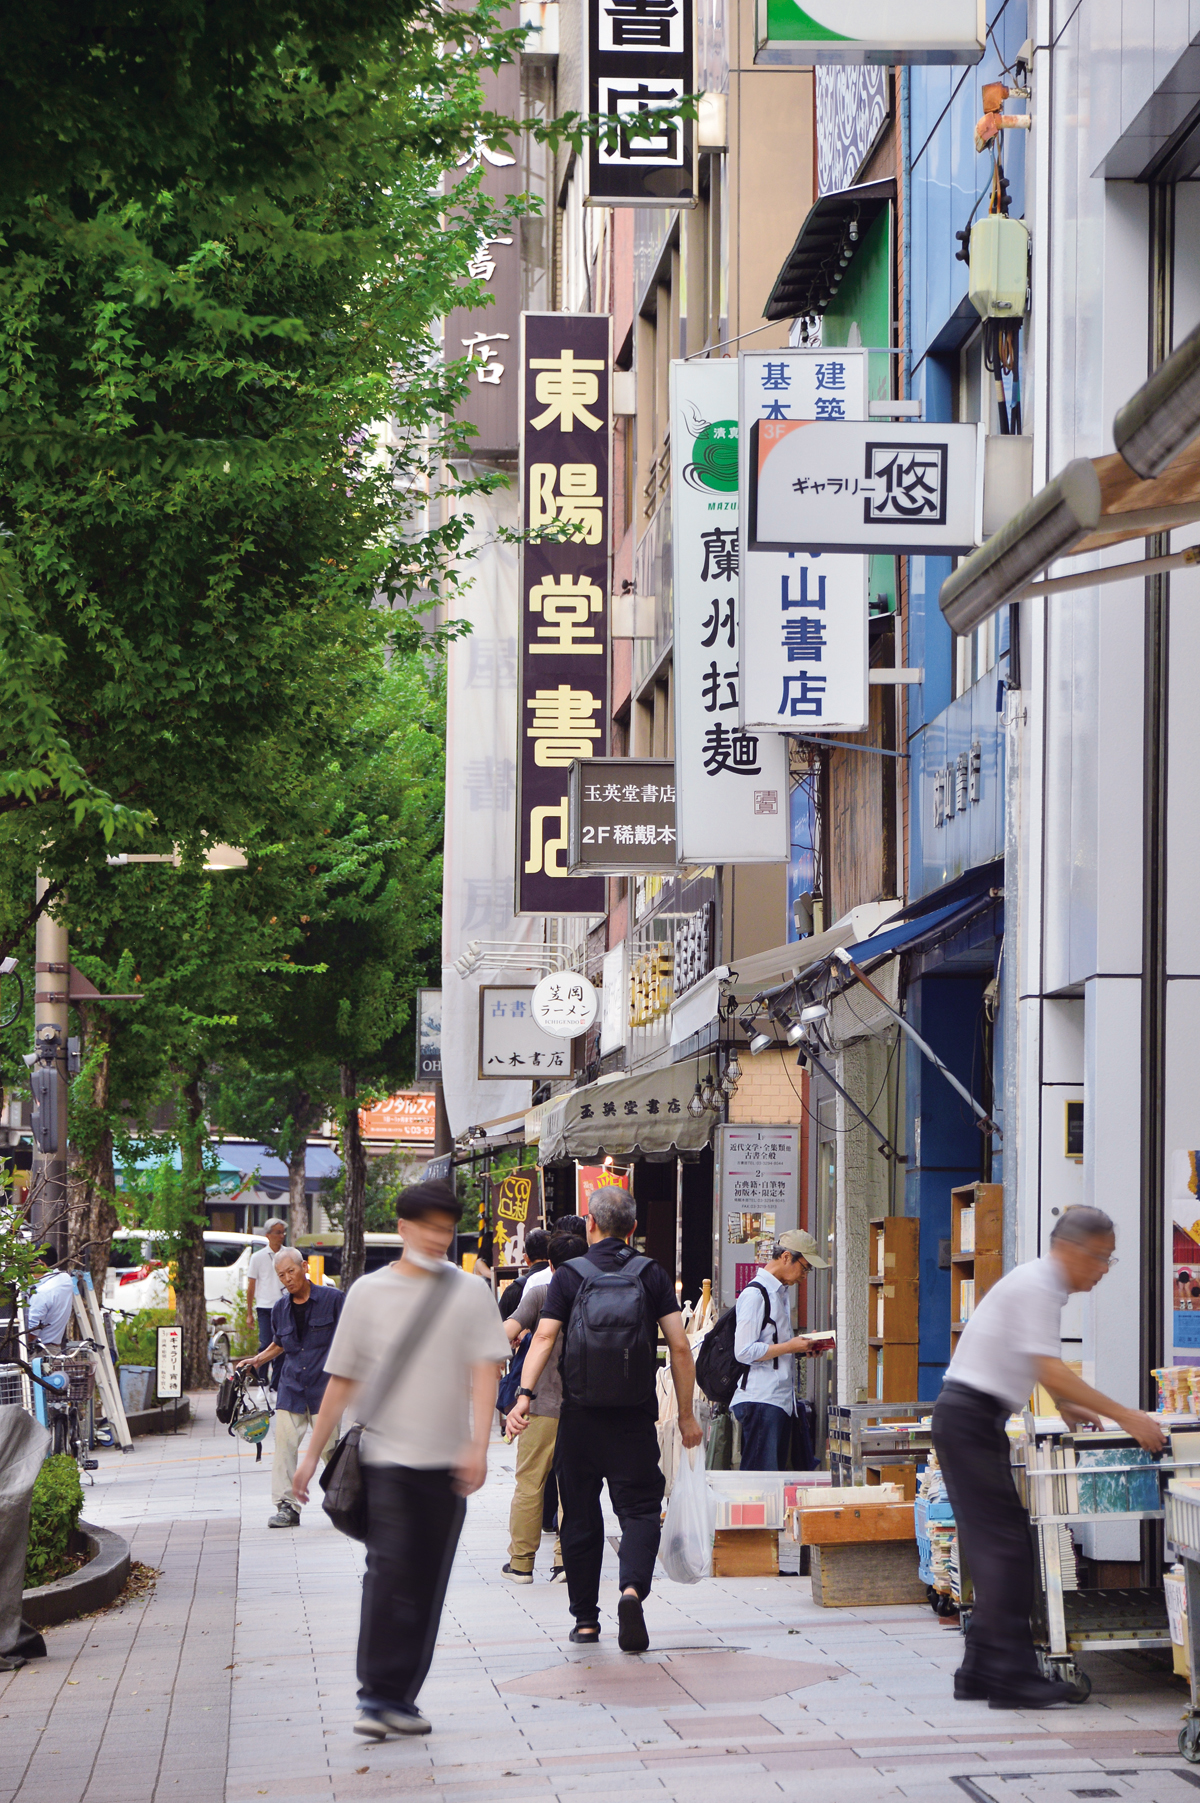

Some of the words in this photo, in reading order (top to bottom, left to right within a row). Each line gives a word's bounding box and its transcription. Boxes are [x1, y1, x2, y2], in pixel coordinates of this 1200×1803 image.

[764, 424, 786, 439] 3F
[792, 477, 875, 495] ギャラリー
[874, 451, 938, 516] 悠
[708, 502, 738, 511] MAZU
[777, 552, 827, 717] 山書店
[584, 784, 675, 803] 玉英堂書店
[582, 826, 611, 844] 2F
[491, 1000, 533, 1018] 古書
[541, 1005, 591, 1017] ラーメン
[488, 1052, 565, 1068] 八木書店
[581, 1099, 683, 1120] 玉英堂書店
